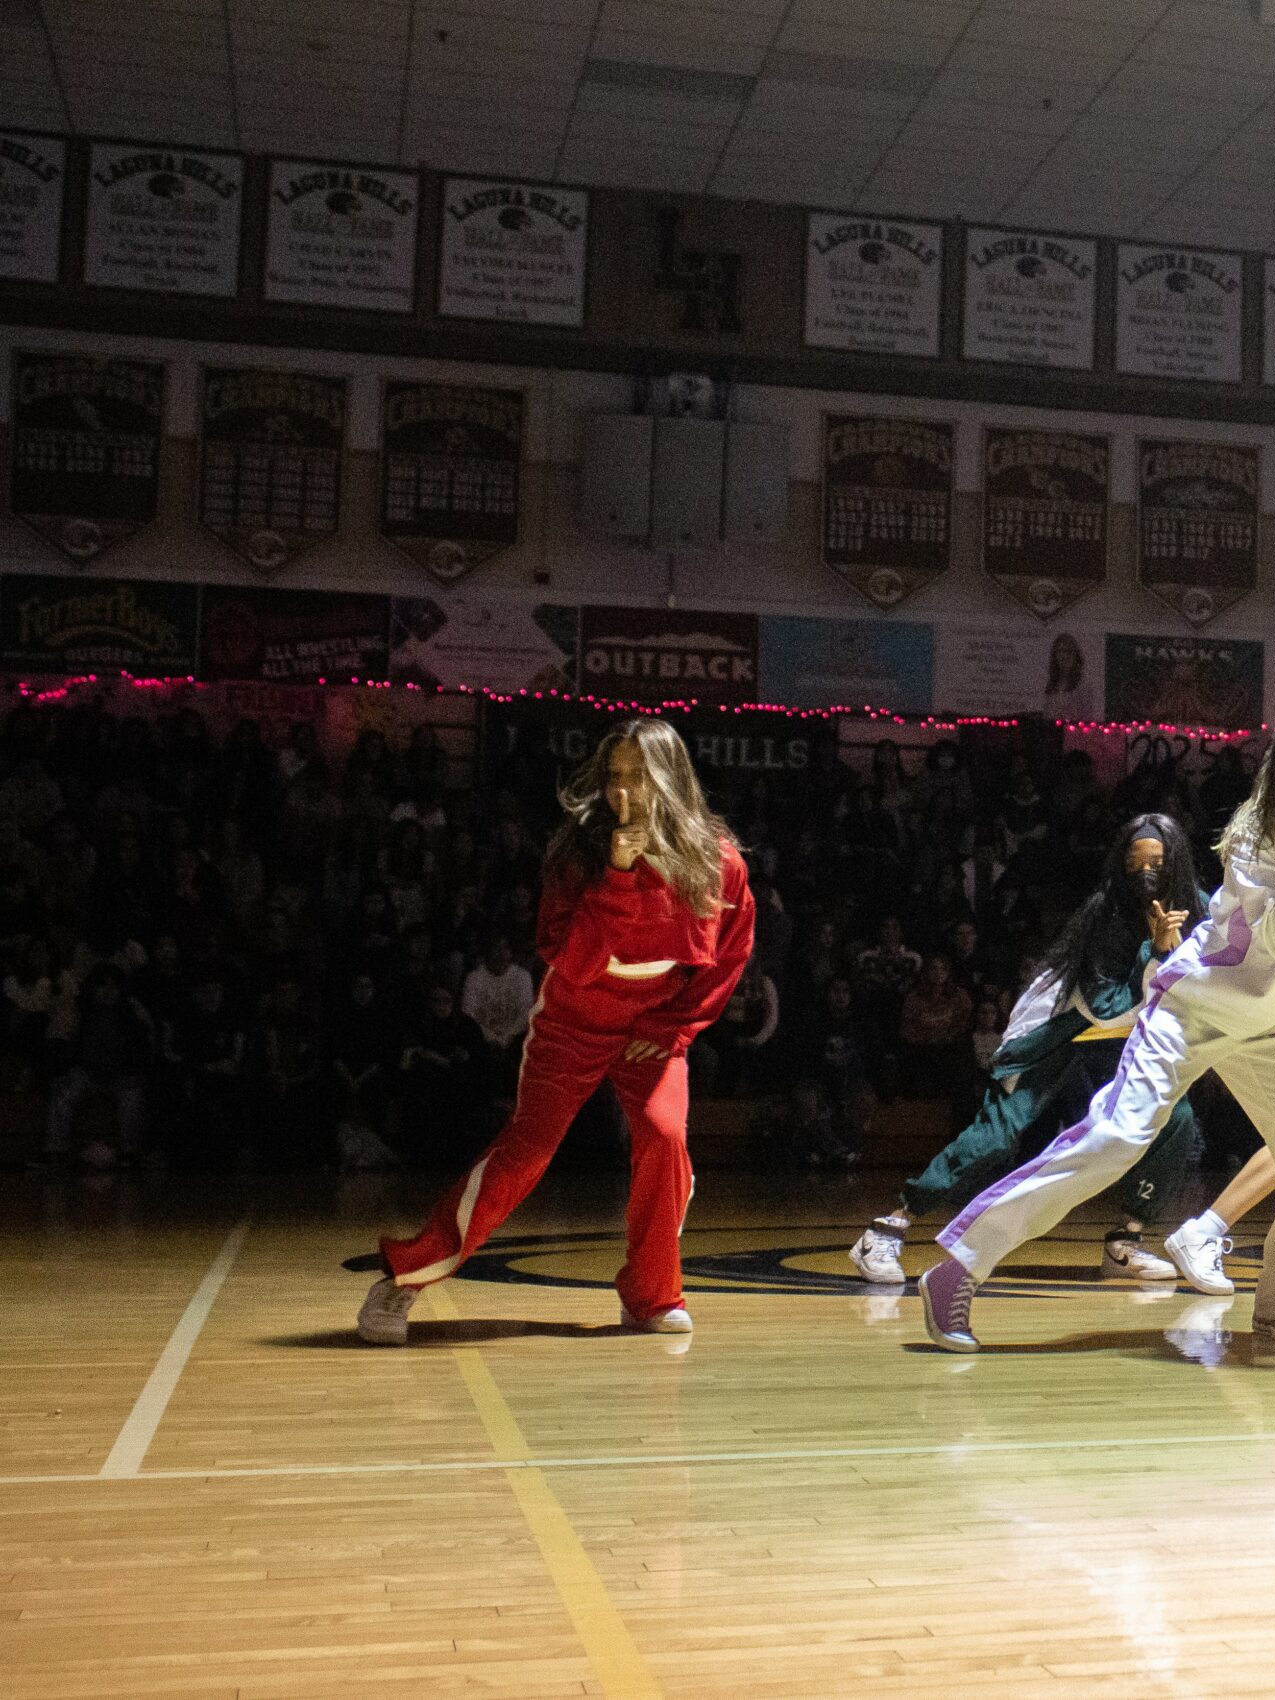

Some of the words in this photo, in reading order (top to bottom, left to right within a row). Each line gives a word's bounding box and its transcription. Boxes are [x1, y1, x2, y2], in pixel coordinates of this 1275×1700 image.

[94, 154, 176, 188] LAGUNA
[182, 158, 239, 199] HILLS
[273, 171, 354, 205] LAGUNA
[357, 175, 413, 216] HILLS
[447, 188, 525, 223] LAGUNA
[528, 191, 582, 231] HILLS
[812, 224, 884, 255] LAGUNA
[886, 227, 939, 266] HILLS
[971, 238, 1040, 270] LAGUNA
[1041, 241, 1093, 281] HILLS
[1120, 253, 1187, 285] LAGUNA
[1190, 256, 1240, 294] HILLS
[585, 648, 755, 682] OUTBACK
[1134, 646, 1234, 662] HAWKS
[694, 736, 810, 769] HILLS
[1137, 1179, 1155, 1200] 12
